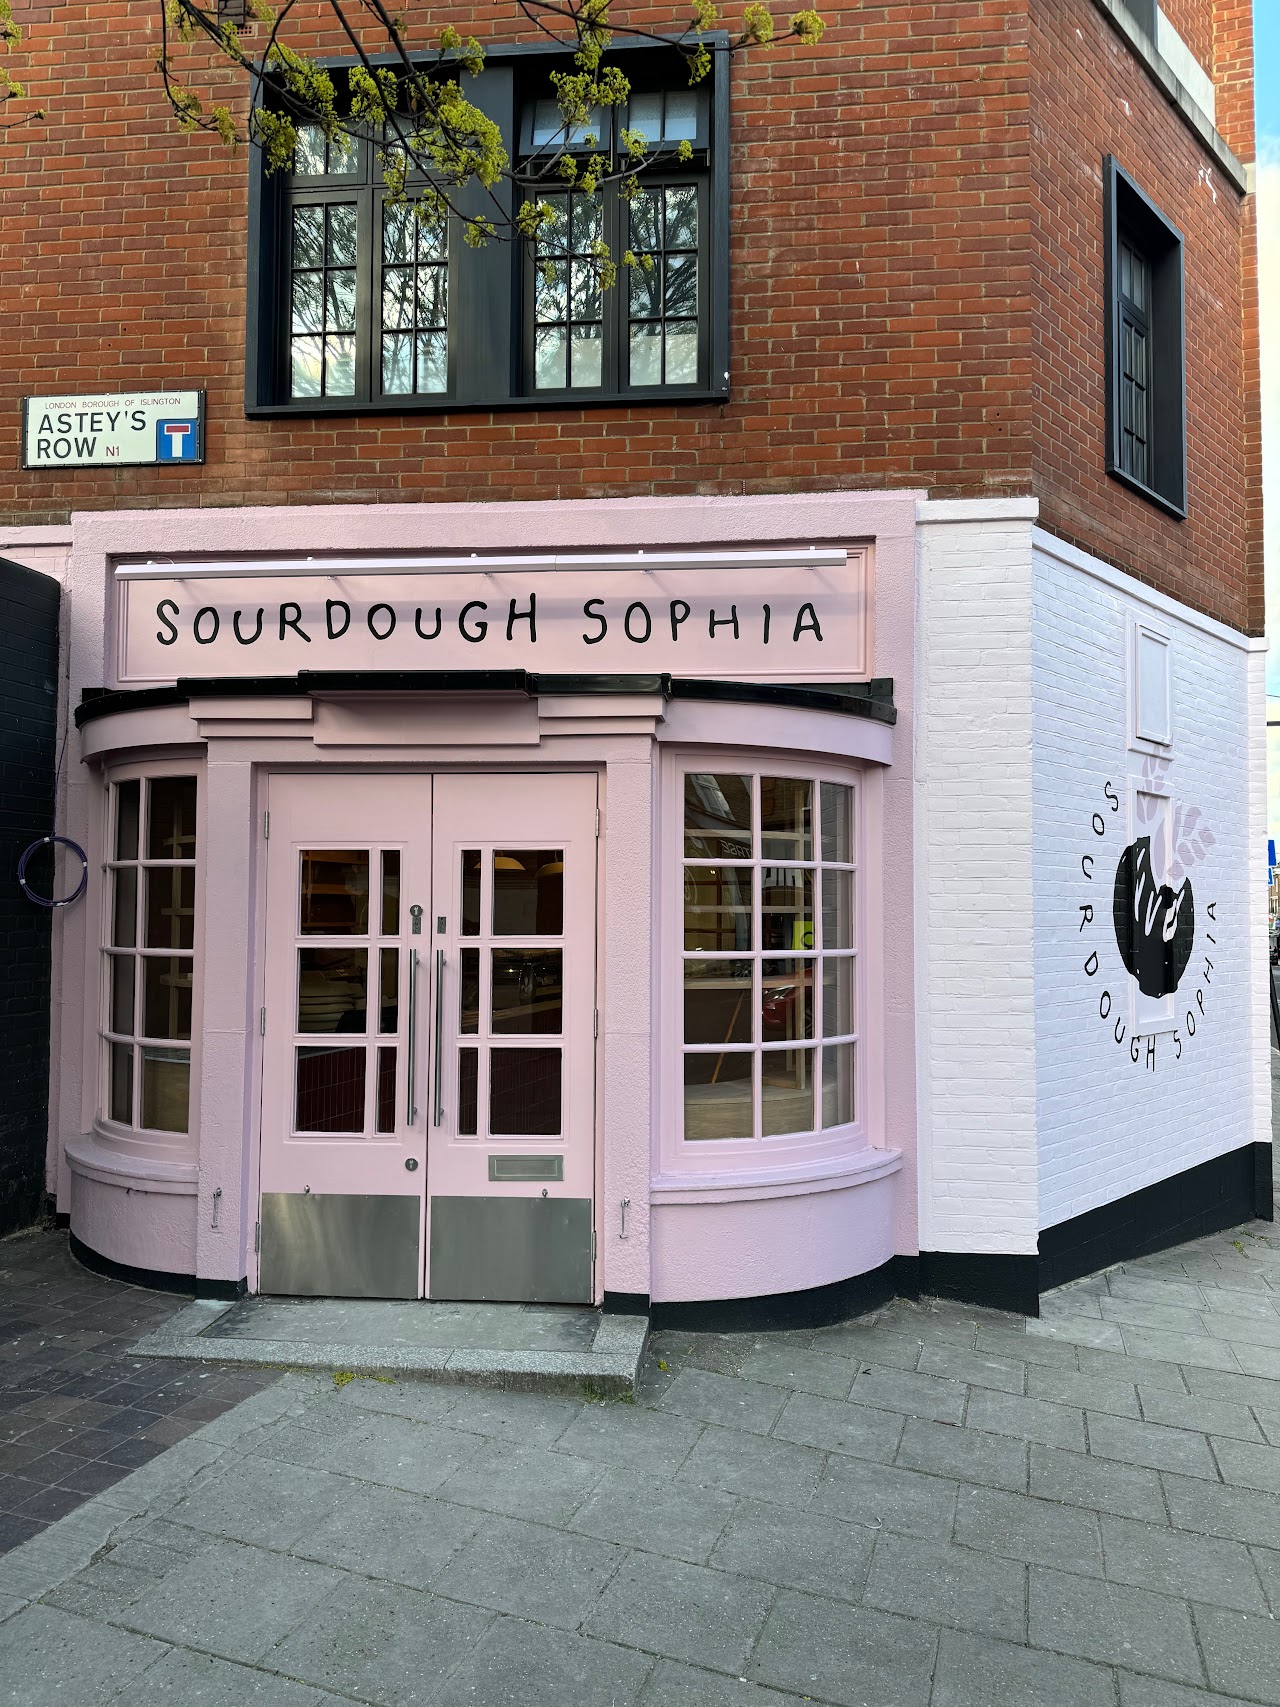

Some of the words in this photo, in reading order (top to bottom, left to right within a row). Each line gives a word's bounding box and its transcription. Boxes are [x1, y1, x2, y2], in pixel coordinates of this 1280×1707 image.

[45, 401, 77, 410] LONDON
[82, 399, 120, 409] BOROUGH
[124, 399, 135, 407] OF
[140, 397, 181, 406] ISLINGTON
[38, 410, 147, 435] ASTEY'S
[37, 436, 97, 459] ROW
[105, 445, 120, 457] N1
[156, 592, 536, 645] SOURDOUGH
[582, 599, 824, 645] SOPHIA
[1079, 780, 1156, 1072] SOURDOUGH
[1173, 901, 1218, 1060] SOPHIA
